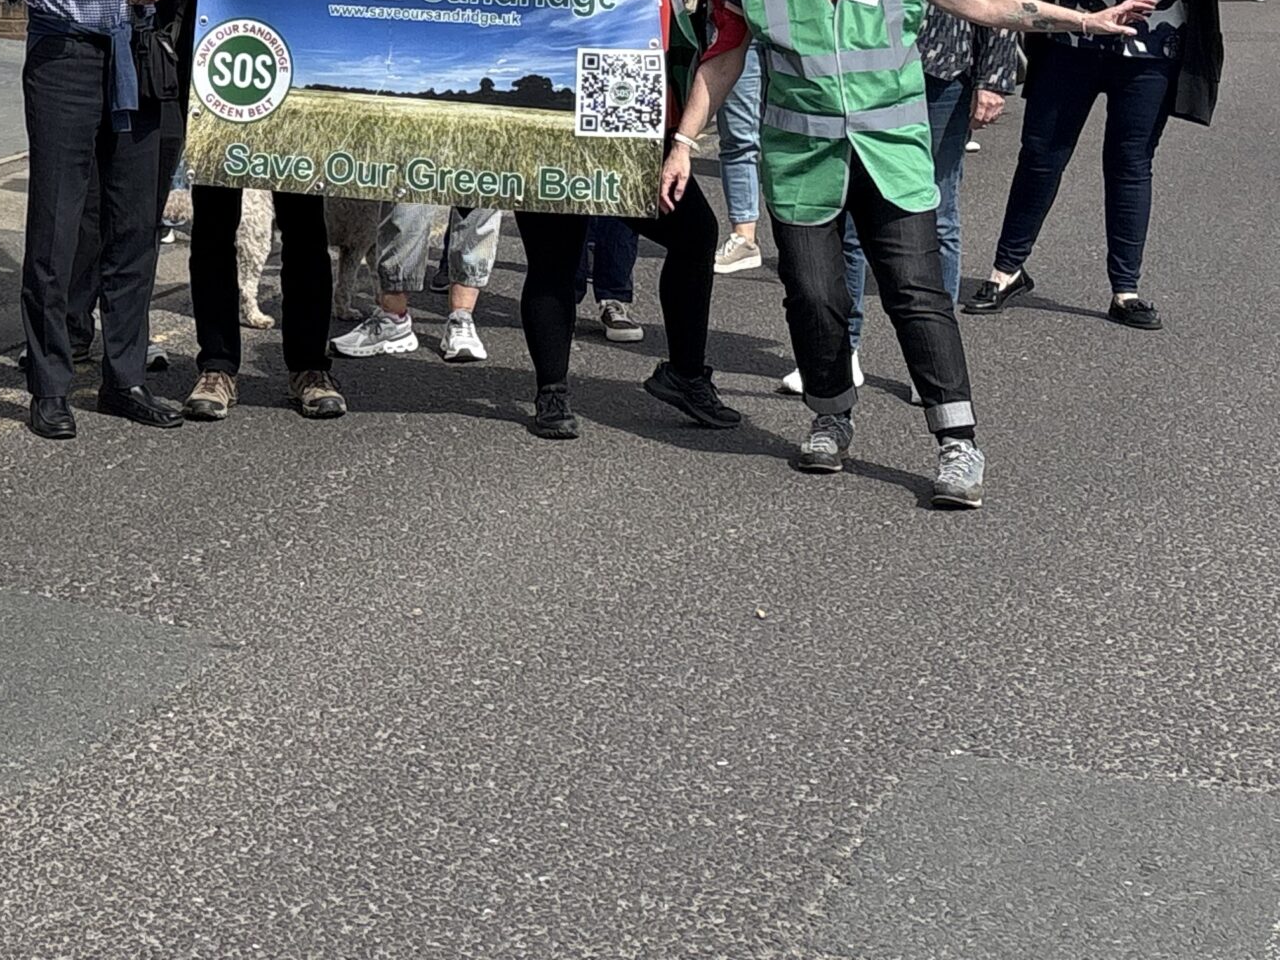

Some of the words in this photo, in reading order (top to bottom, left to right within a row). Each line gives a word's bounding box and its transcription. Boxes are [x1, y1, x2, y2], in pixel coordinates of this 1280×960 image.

[328, 3, 522, 27] www.saveoursandridge.uk
[197, 38, 216, 67] SAVE
[215, 24, 240, 40] OUR
[242, 23, 289, 74] SANDRIDGE
[212, 51, 273, 90] SOS
[205, 93, 243, 119] GREEN
[248, 98, 274, 118] BELT
[224, 143, 315, 182] Save
[325, 151, 396, 189] Our
[406, 157, 524, 199] Green
[538, 165, 620, 202] Belt
